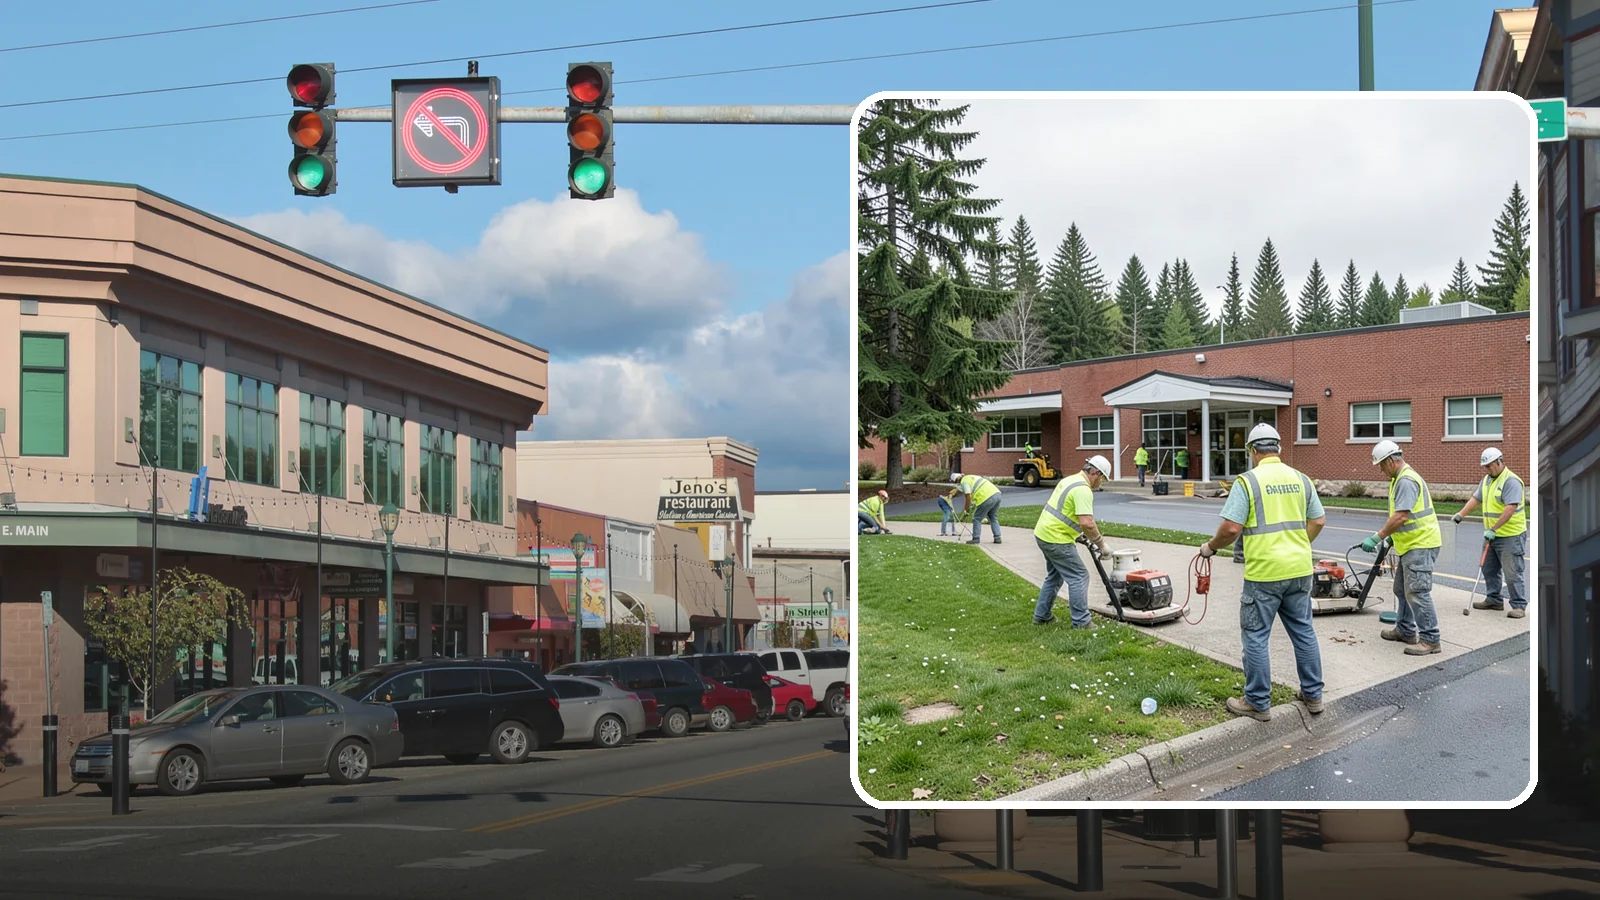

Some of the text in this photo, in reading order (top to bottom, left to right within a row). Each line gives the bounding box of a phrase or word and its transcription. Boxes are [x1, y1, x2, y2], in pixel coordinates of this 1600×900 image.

[669, 480, 727, 494] Jeno's
[664, 496, 731, 509] restaurant
[658, 510, 681, 520] Italian
[686, 510, 714, 519] American
[715, 509, 737, 519] Cuisine
[2, 525, 49, 537] E. MAIN
[797, 608, 829, 617] Street
